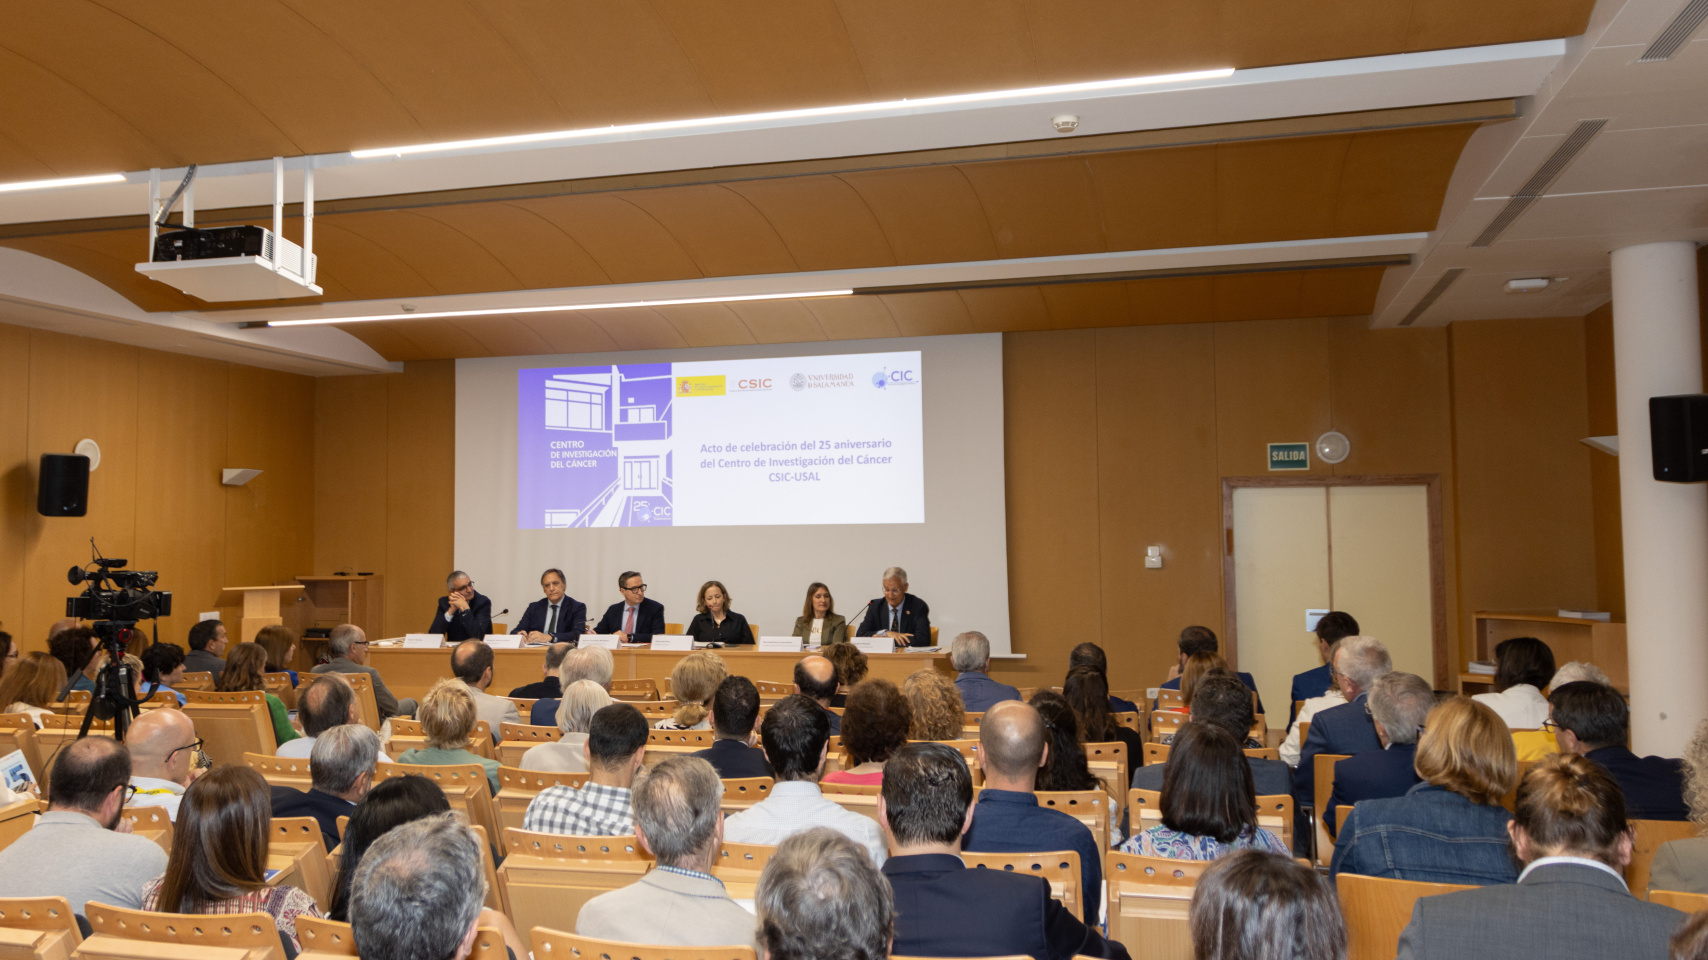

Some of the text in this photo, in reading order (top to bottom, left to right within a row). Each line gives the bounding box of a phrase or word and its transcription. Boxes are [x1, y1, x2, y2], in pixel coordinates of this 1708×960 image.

[890, 370, 913, 382] CIC
[738, 378, 772, 389] CSIC
[550, 440, 585, 449] CENTRO
[700, 438, 892, 453] Acto de celebración del 25 aniversario
[550, 449, 617, 459] DE INVESTIGACIÓN
[1272, 451, 1306, 461] SALIDA
[566, 459, 597, 468] CÁNCER
[700, 454, 892, 469] del Centro de Investigación del Cáncer
[768, 471, 821, 482] CSIC-USAL
[633, 501, 648, 512] 25
[653, 506, 672, 516] CIC
